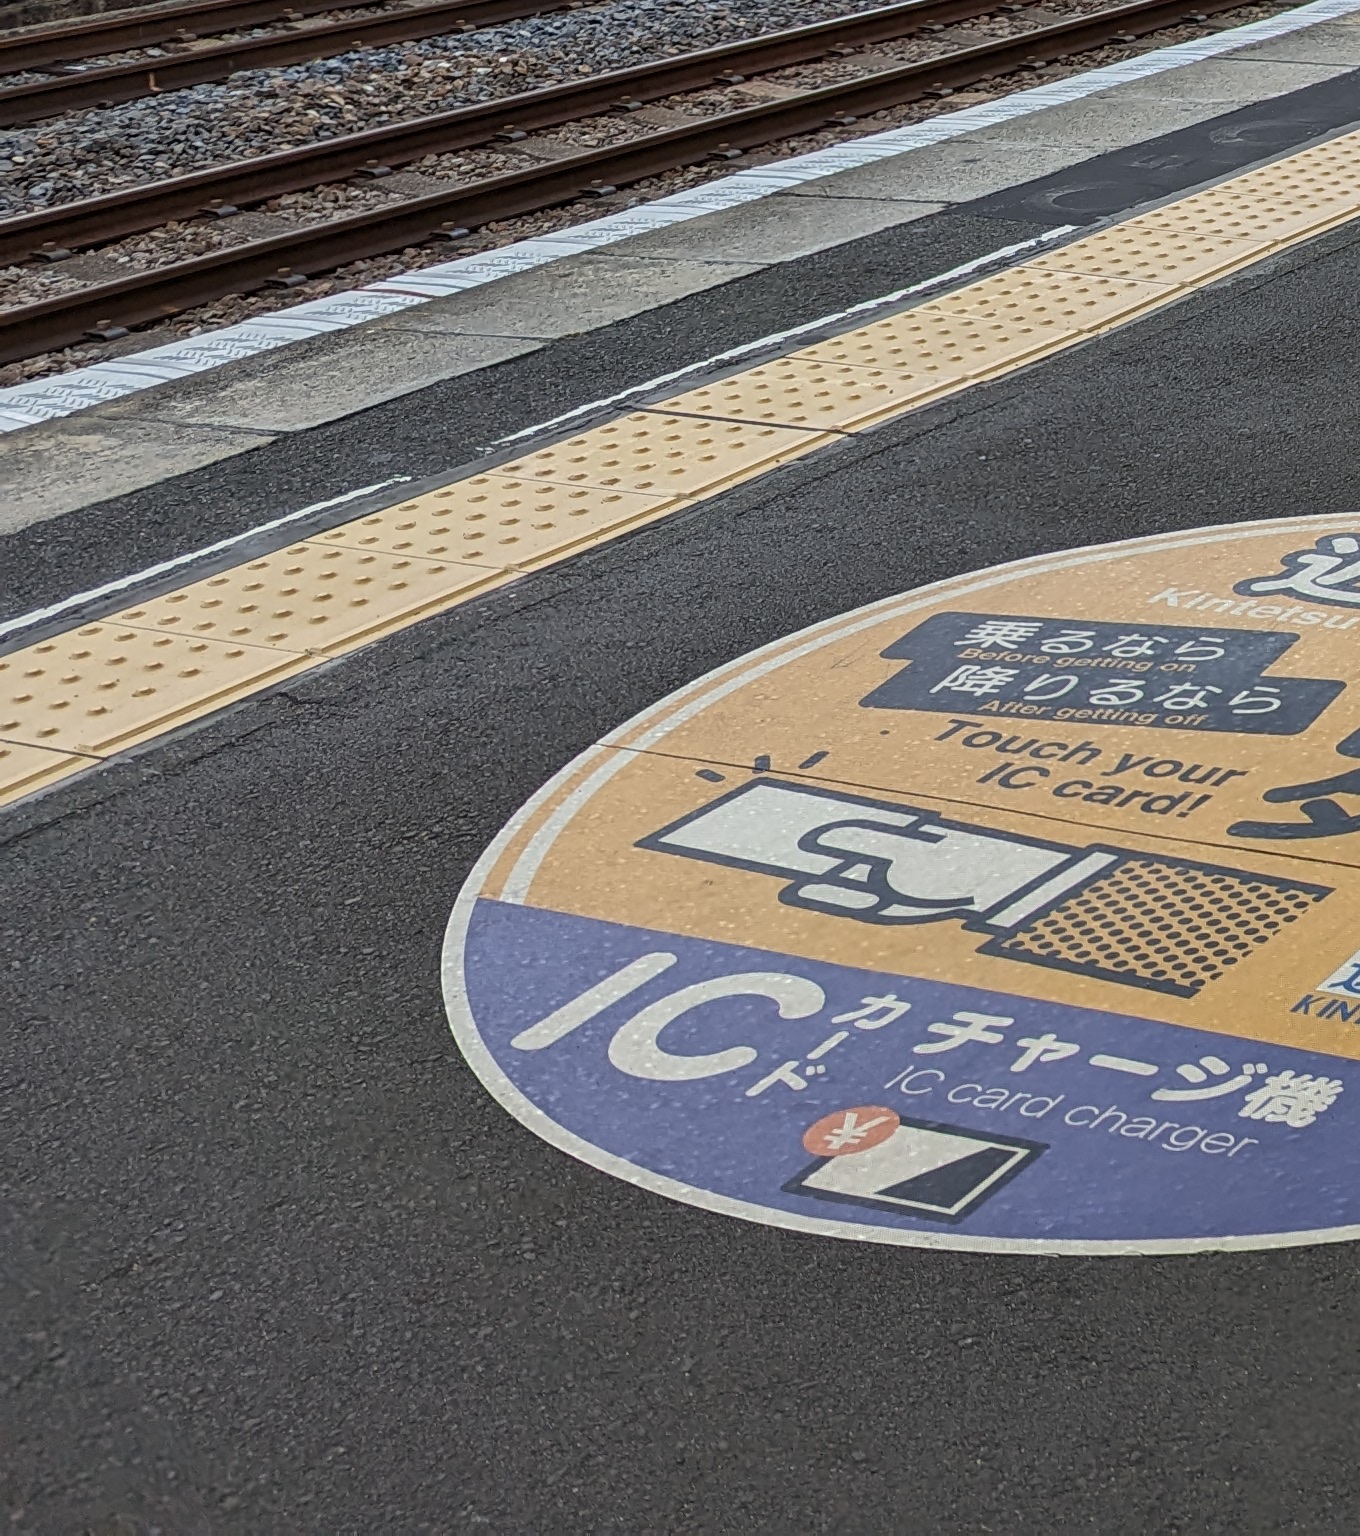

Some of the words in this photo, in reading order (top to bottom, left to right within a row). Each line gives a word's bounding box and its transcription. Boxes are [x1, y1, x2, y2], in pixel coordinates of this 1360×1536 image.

[1148, 587, 1360, 632] Kintetsu
[953, 619, 1227, 663] 乗るなら
[956, 647, 1053, 666] Before
[1054, 654, 1157, 674] getting
[1159, 662, 1197, 674] on
[929, 663, 1283, 716] 降りるなら
[977, 698, 1051, 718] After
[1050, 703, 1158, 727] getting
[1162, 712, 1209, 728] off
[933, 719, 1104, 766] Touch
[1099, 752, 1251, 789] your
[976, 761, 1053, 790] IC
[1051, 774, 1212, 820] card!
[509, 950, 828, 1083] IC
[924, 1008, 1348, 1131] チャージ機
[882, 1063, 947, 1097] IC
[948, 1074, 1064, 1123] card
[1072, 1101, 1262, 1163] charger
